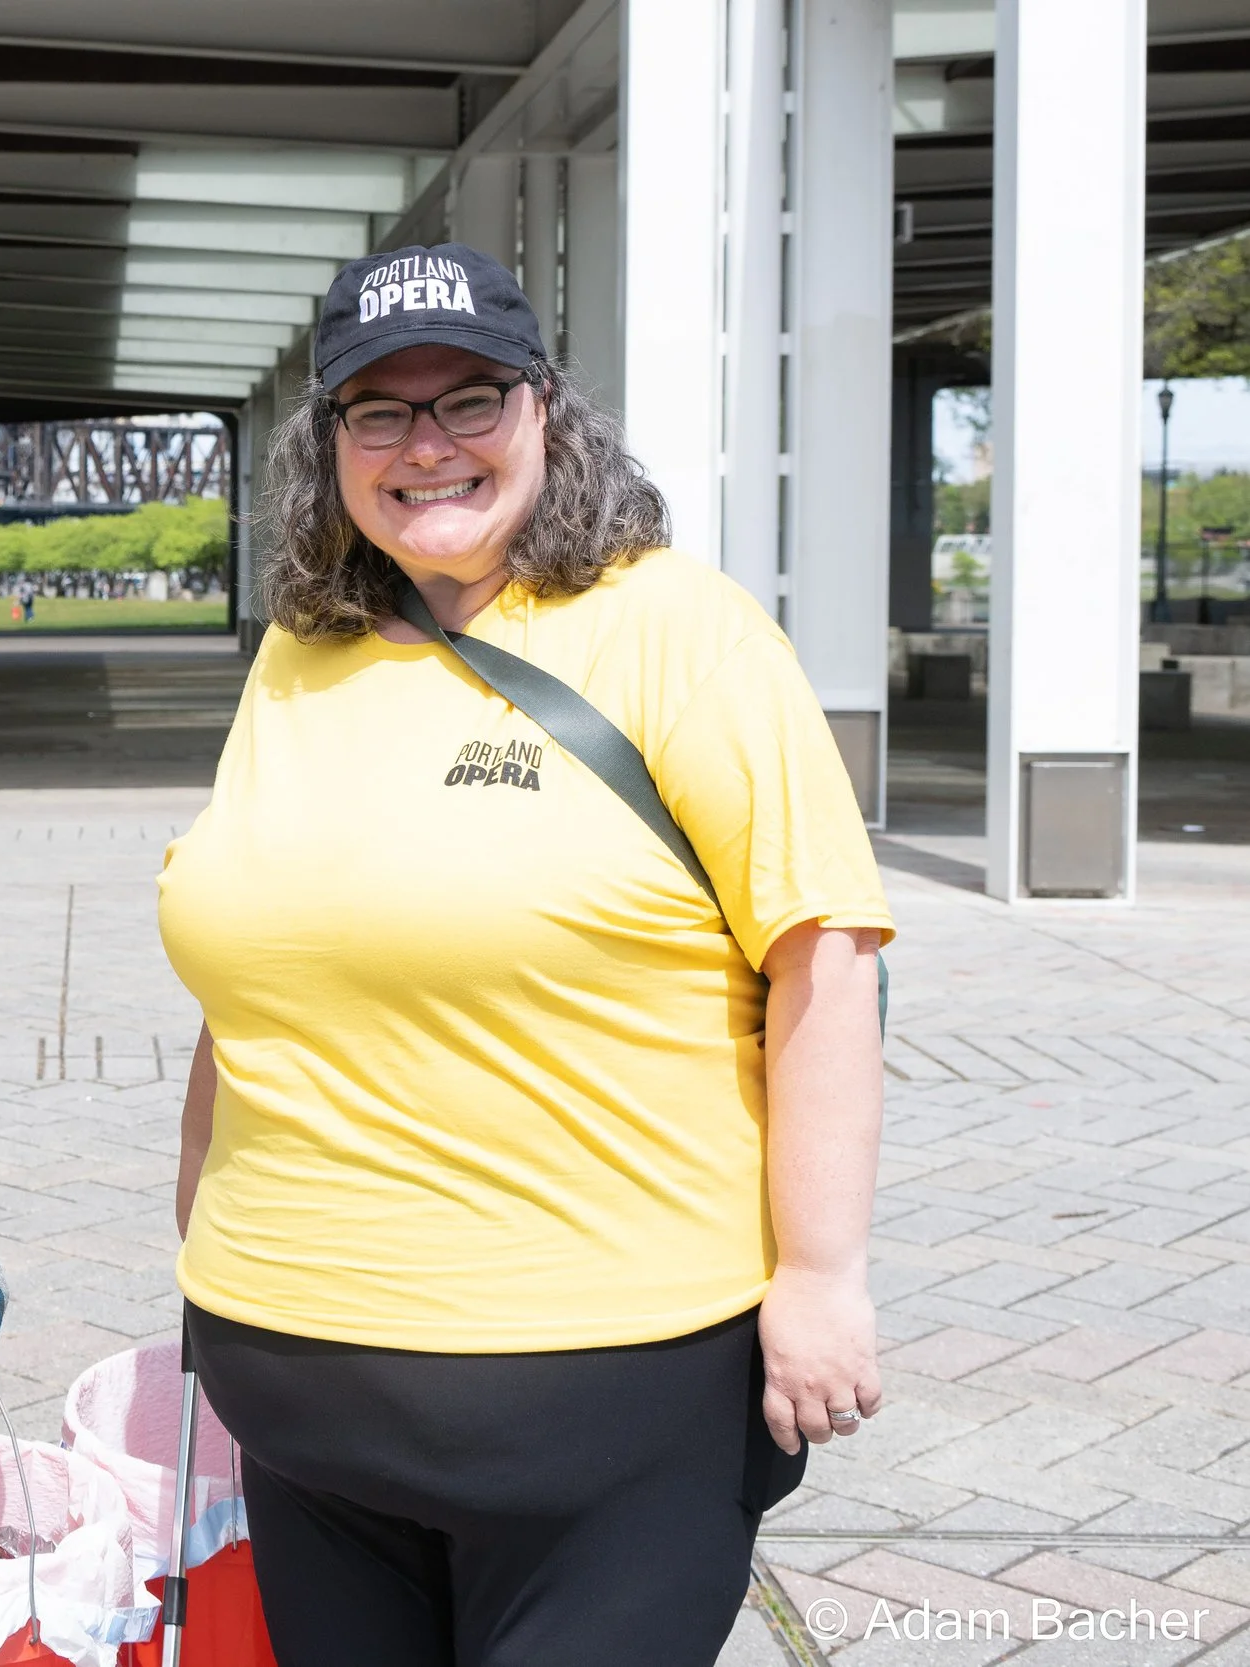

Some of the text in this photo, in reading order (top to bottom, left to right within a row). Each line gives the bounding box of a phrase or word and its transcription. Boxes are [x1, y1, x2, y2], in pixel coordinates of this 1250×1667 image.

[359, 255, 469, 293] PORTLAND
[358, 278, 477, 324] OPERA
[443, 761, 541, 792] OPERA
